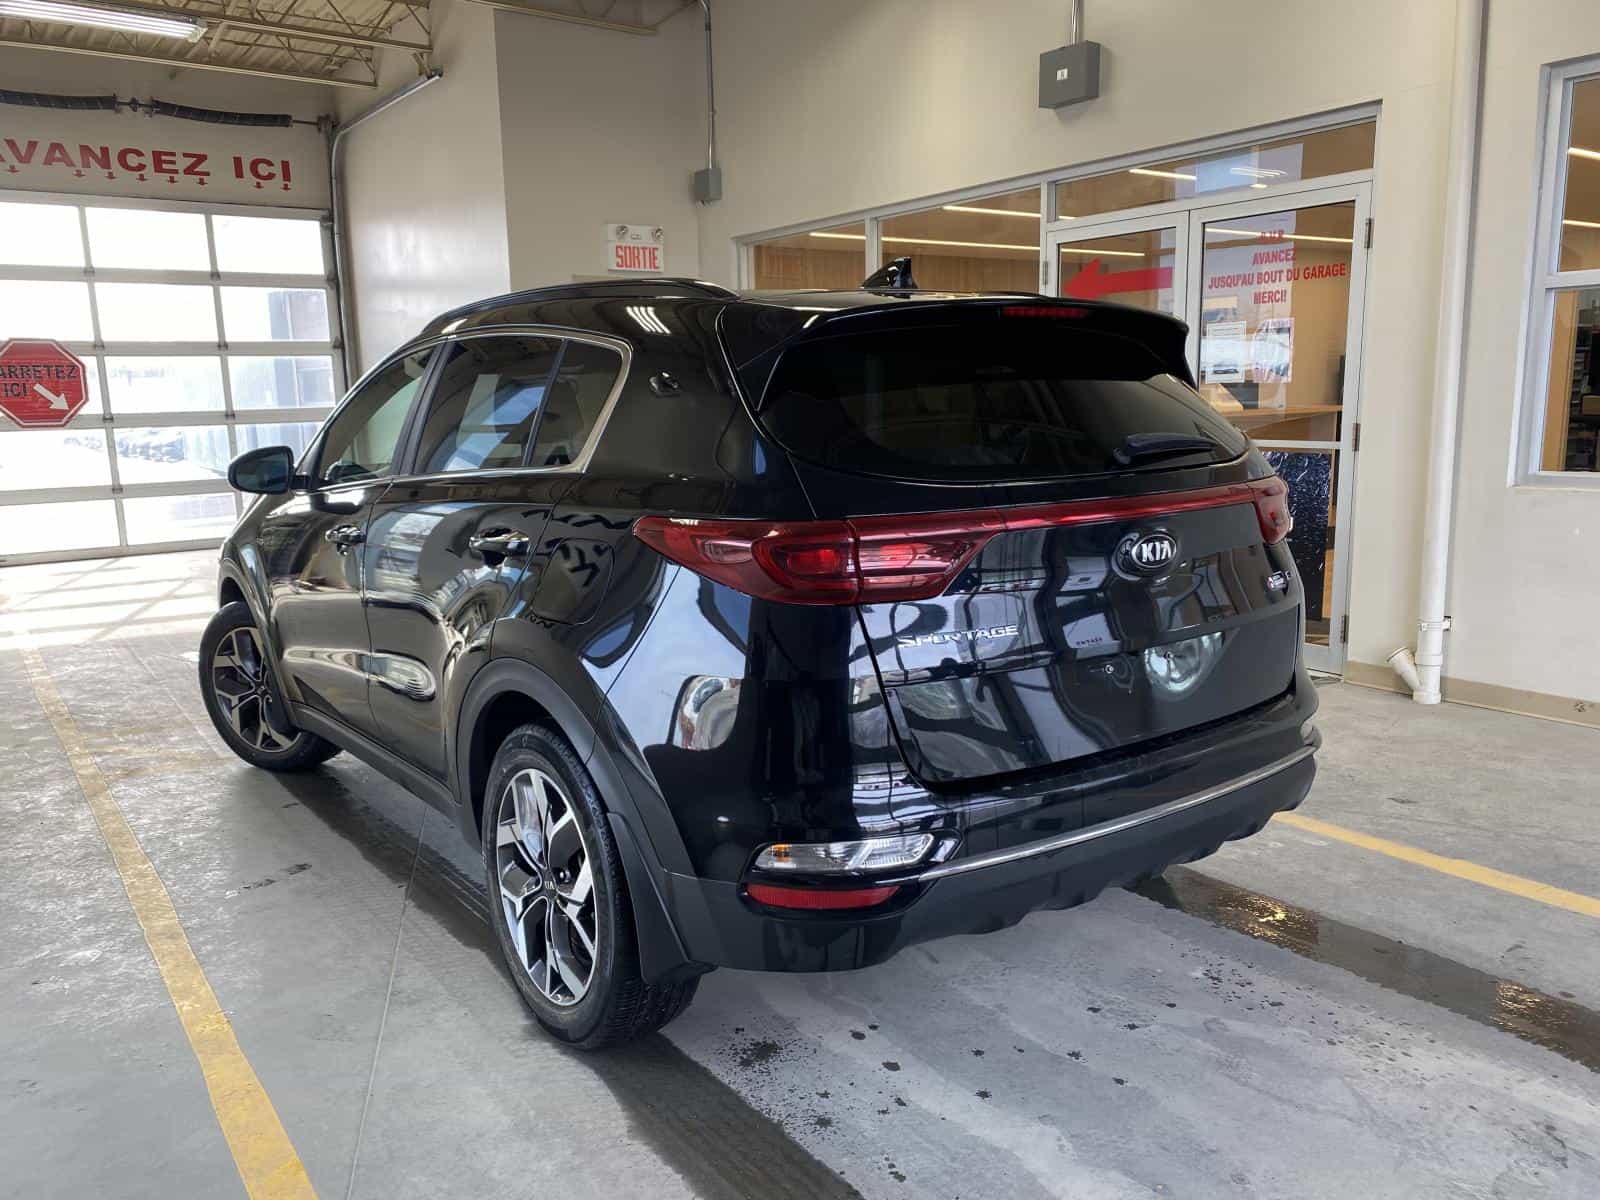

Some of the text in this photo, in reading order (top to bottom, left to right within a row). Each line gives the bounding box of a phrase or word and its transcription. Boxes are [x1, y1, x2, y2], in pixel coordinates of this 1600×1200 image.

[0, 138, 292, 182] VANCEZ ICI
[615, 244, 660, 269] SORTIE
[1252, 248, 1297, 265] AVANCEZ
[1208, 263, 1346, 289] JUSQU'AU BOUT DU GARAGE
[4, 383, 27, 398] ICI
[1141, 541, 1171, 562] KIA
[896, 625, 1019, 648] SPORTAGE
